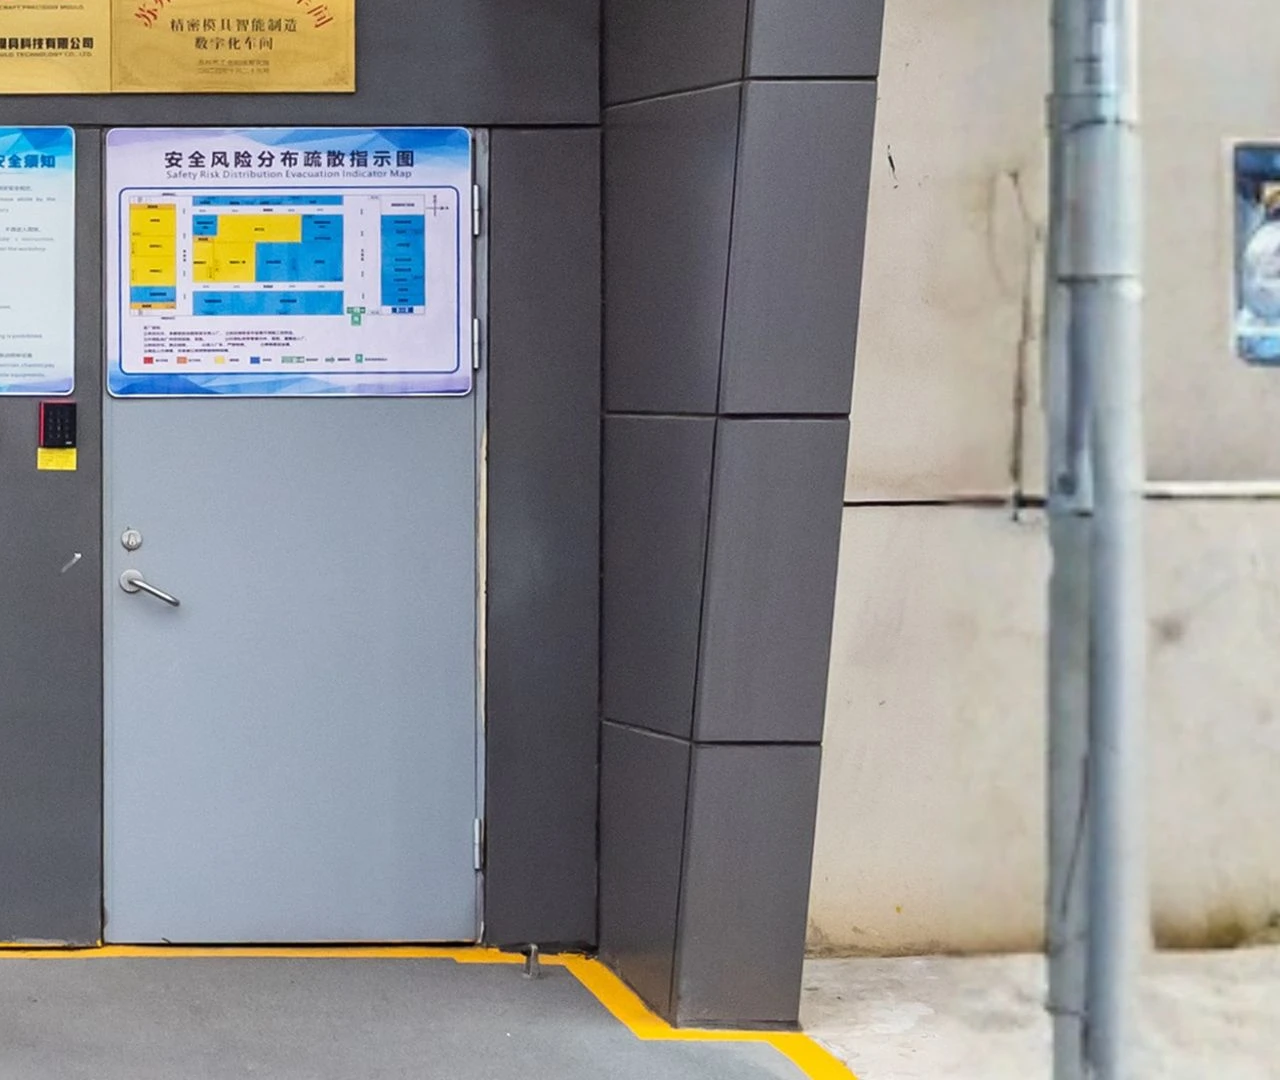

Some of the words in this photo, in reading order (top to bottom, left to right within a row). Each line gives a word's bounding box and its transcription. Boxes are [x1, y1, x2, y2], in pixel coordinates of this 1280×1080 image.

[170, 18, 298, 33] 精密模具智能制造
[195, 36, 274, 51] 数字化车间
[164, 150, 416, 169] 安全风险分布疏散指示图
[166, 170, 198, 180] Safety
[200, 170, 220, 179] Risk
[222, 170, 283, 179] Distribution
[285, 170, 340, 179] Evacuation
[342, 169, 388, 178] Indicator
[390, 169, 413, 179] Map
